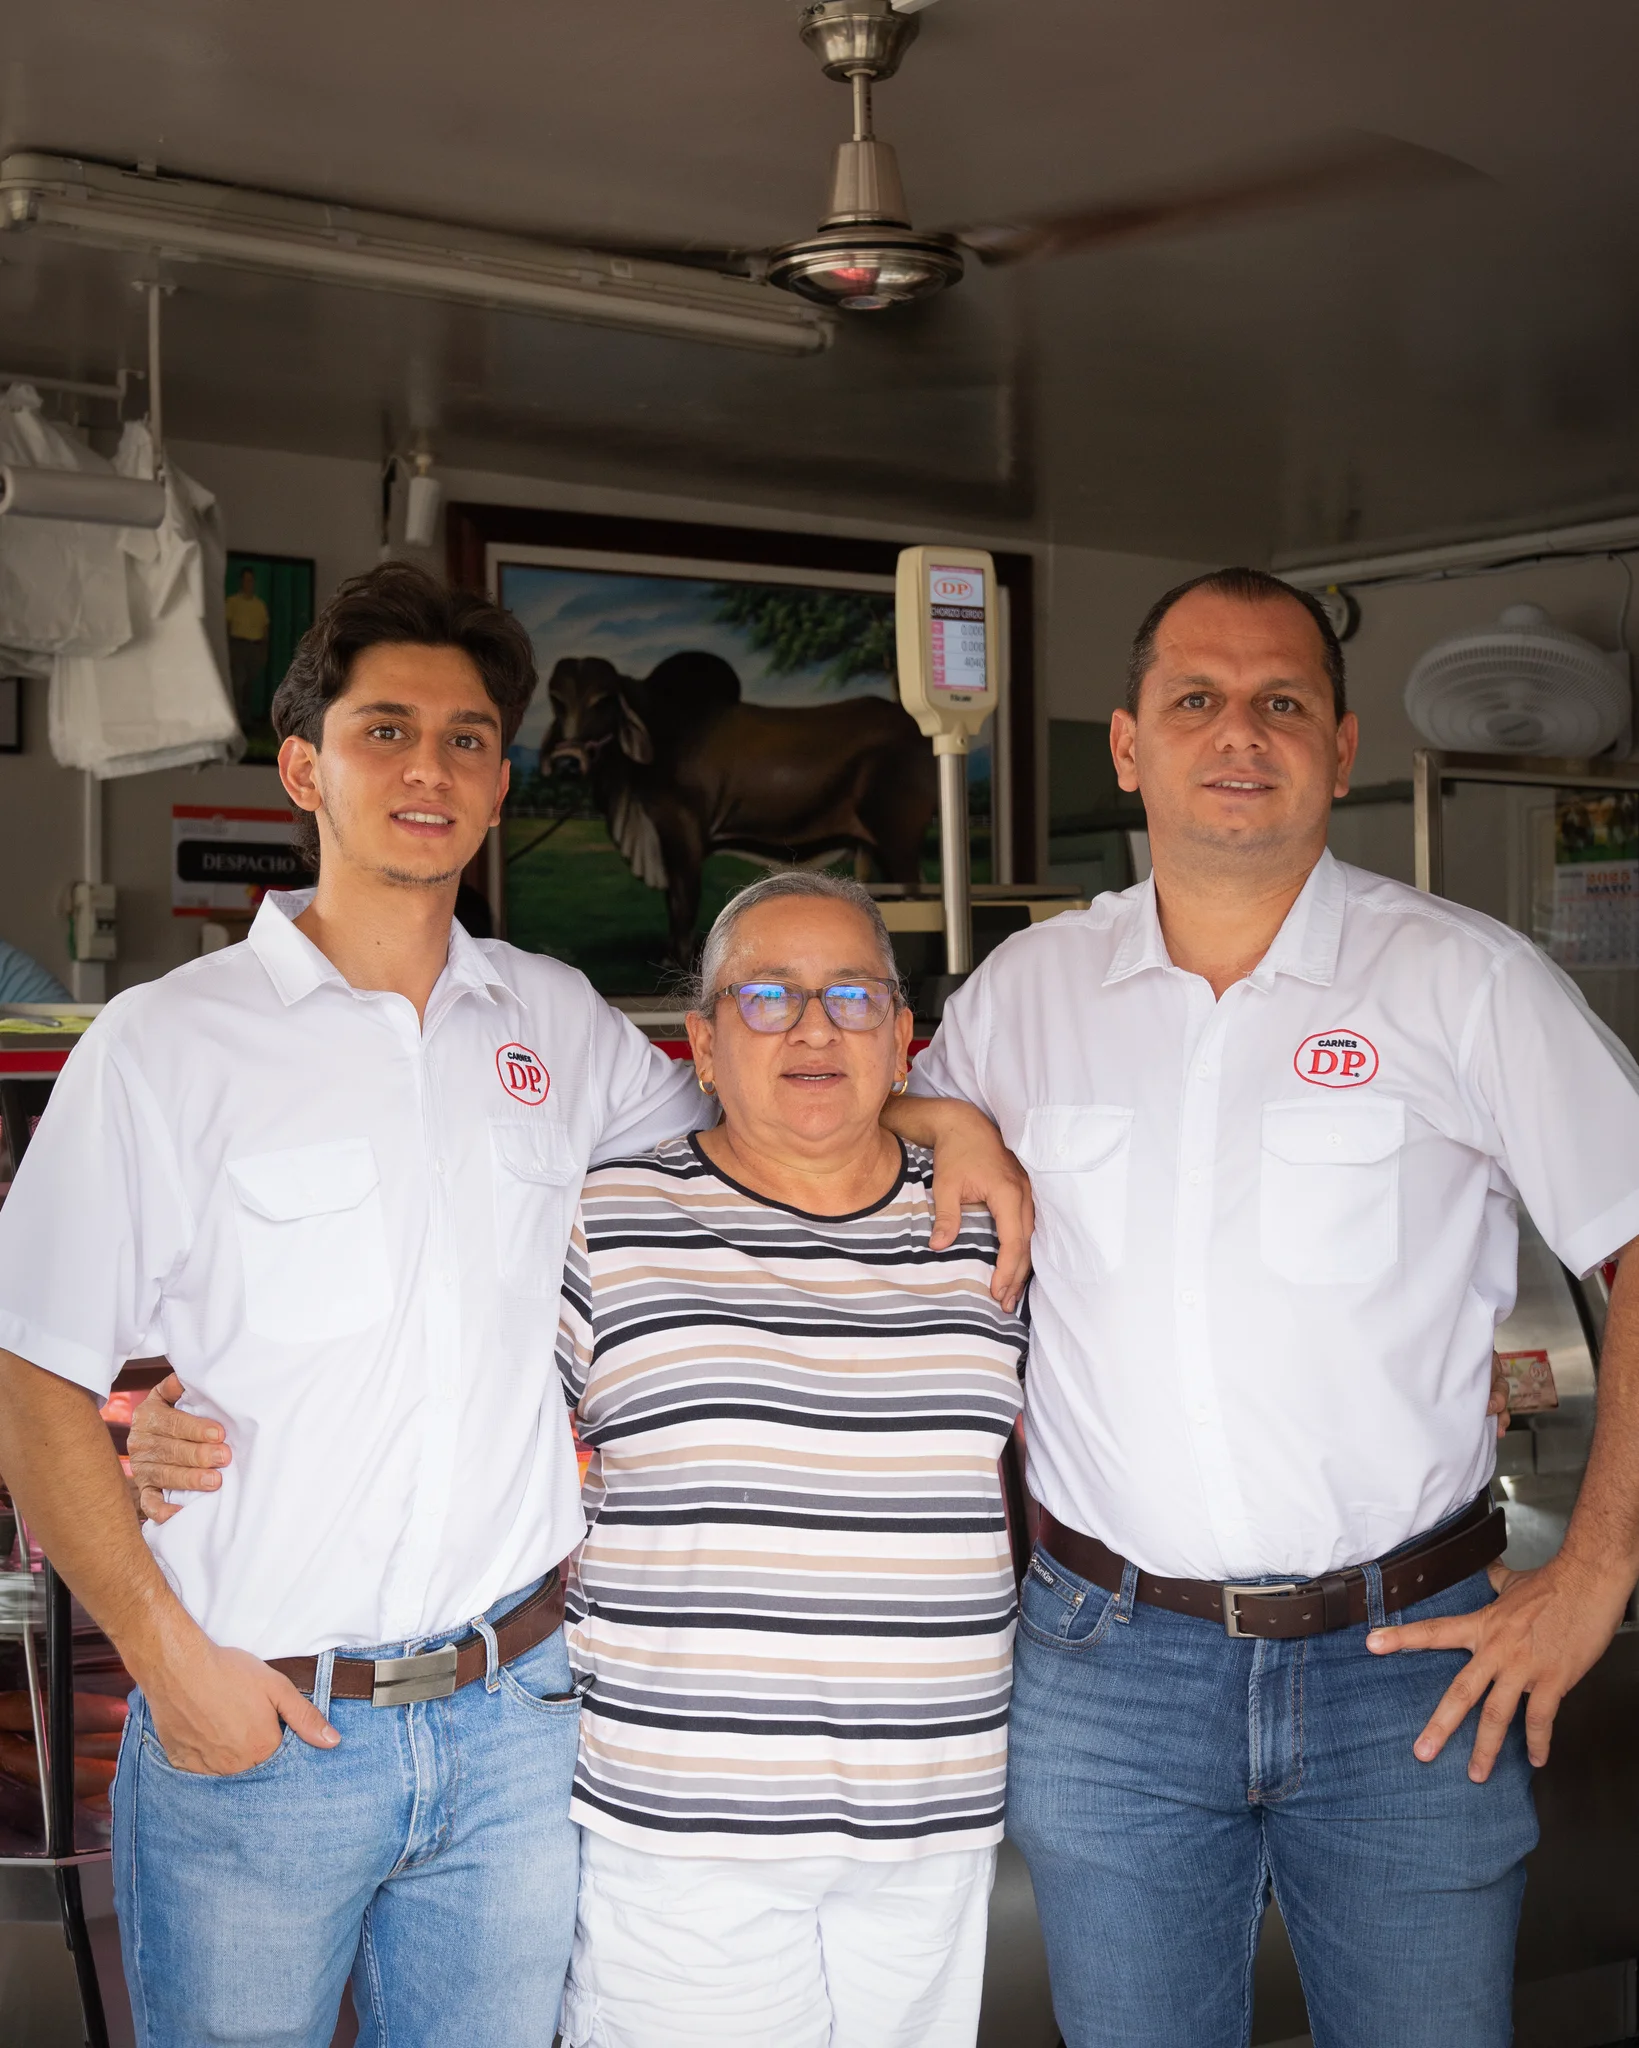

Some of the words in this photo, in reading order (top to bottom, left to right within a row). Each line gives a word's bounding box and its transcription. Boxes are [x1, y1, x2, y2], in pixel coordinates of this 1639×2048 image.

[941, 582, 969, 595] DP
[202, 852, 296, 874] DESPACHO
[1318, 1039, 1357, 1048] CARNES
[507, 1051, 532, 1063] CARNES
[1307, 1049, 1366, 1076] DP
[505, 1061, 541, 1092] DP
